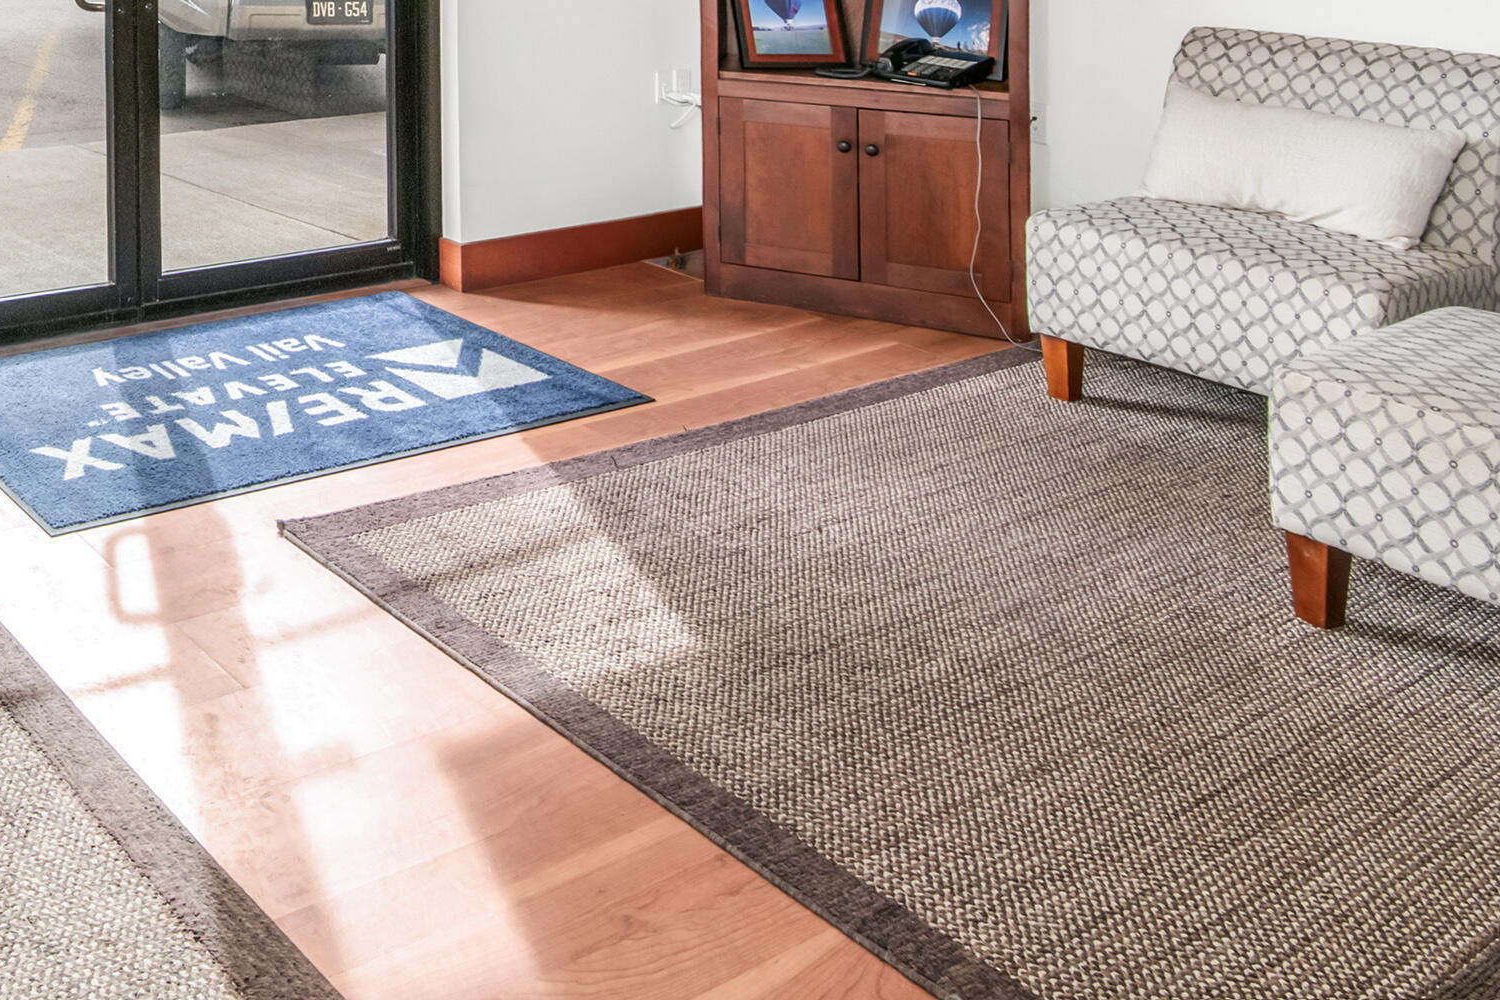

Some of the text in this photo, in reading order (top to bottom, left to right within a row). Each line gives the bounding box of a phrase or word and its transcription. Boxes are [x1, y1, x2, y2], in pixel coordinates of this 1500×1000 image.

[91, 334, 346, 387] Vail Valley
[98, 361, 367, 422] ELEVATE
[31, 379, 428, 481] RE/MAX
